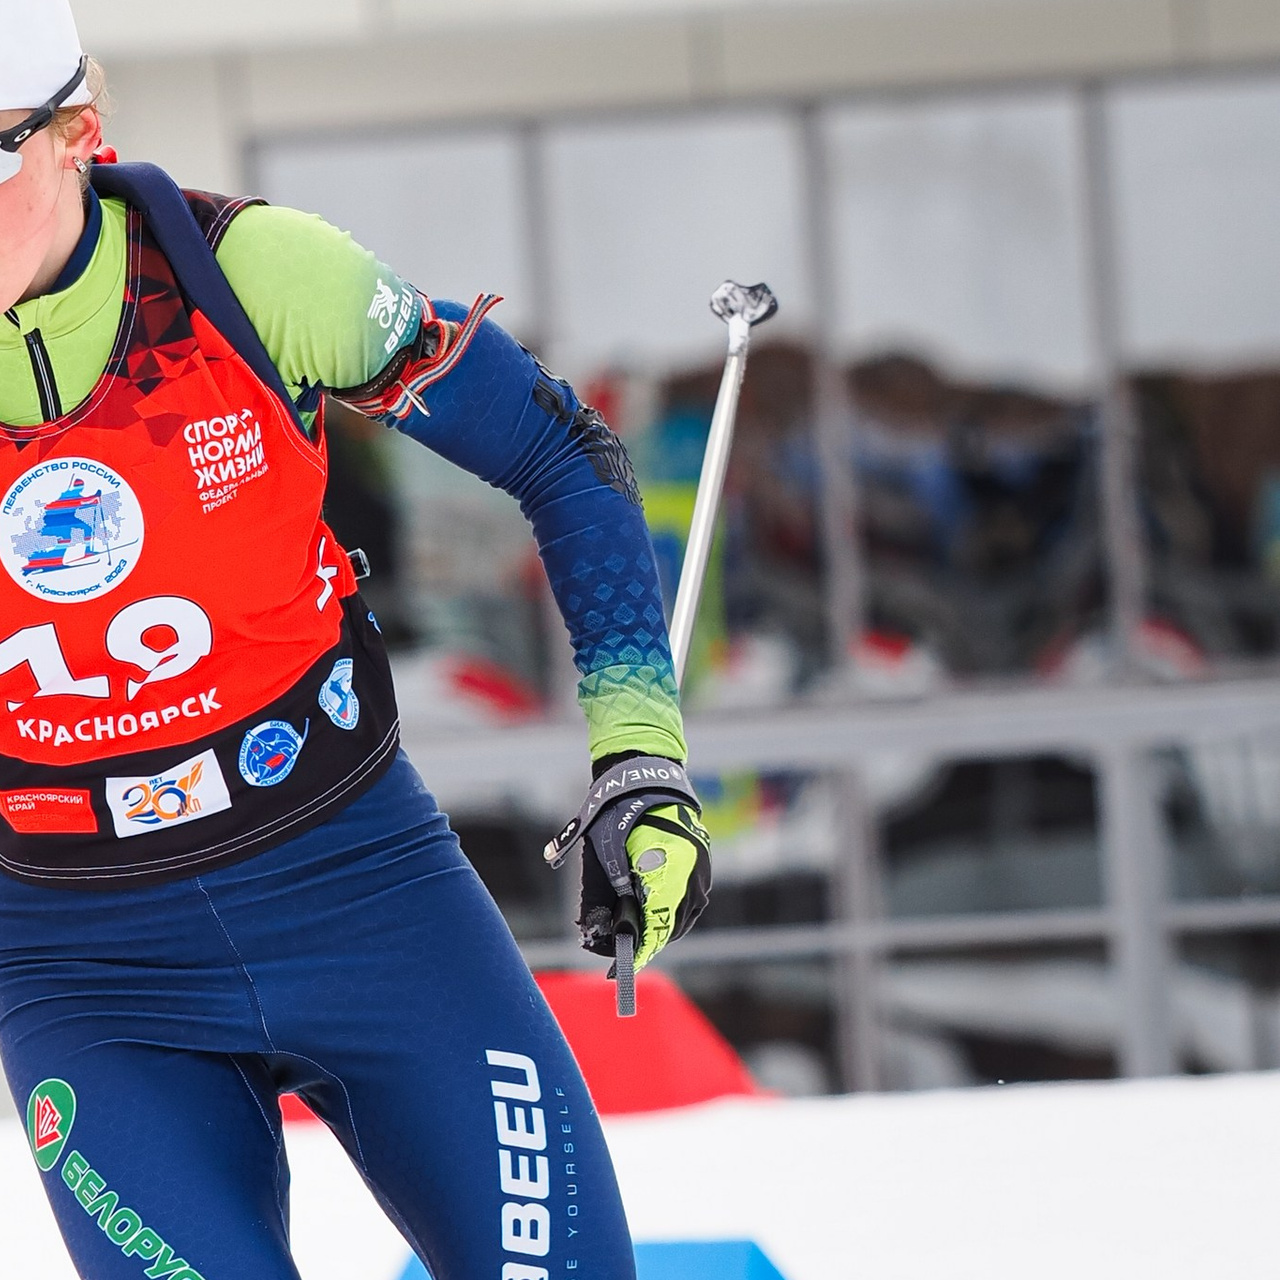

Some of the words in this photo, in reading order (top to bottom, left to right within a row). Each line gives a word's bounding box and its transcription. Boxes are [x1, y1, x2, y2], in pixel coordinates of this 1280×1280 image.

[384, 287, 413, 354] BEEU
[183, 408, 253, 444] СПОРТ
[188, 421, 261, 467] НОРМА
[3, 461, 69, 515] ПЕРВЕНСТВО
[72, 461, 121, 488] РОССИИ
[194, 441, 265, 489] ЖИЗНИ
[202, 489, 237, 514] ПРОЕКТ
[36, 583, 101, 596] Красноярск
[104, 559, 127, 583] 2023
[16, 687, 222, 746] КРАСНОЯРСК
[7, 793, 84, 805] КРАСНОЯРСКИЙ
[149, 776, 163, 785] ЛЕТ
[588, 768, 670, 815] ONE/WAY
[8, 801, 35, 812] КРАЙ
[484, 1049, 551, 1257] BEEU
[555, 1087, 578, 1238] YOURSELF
